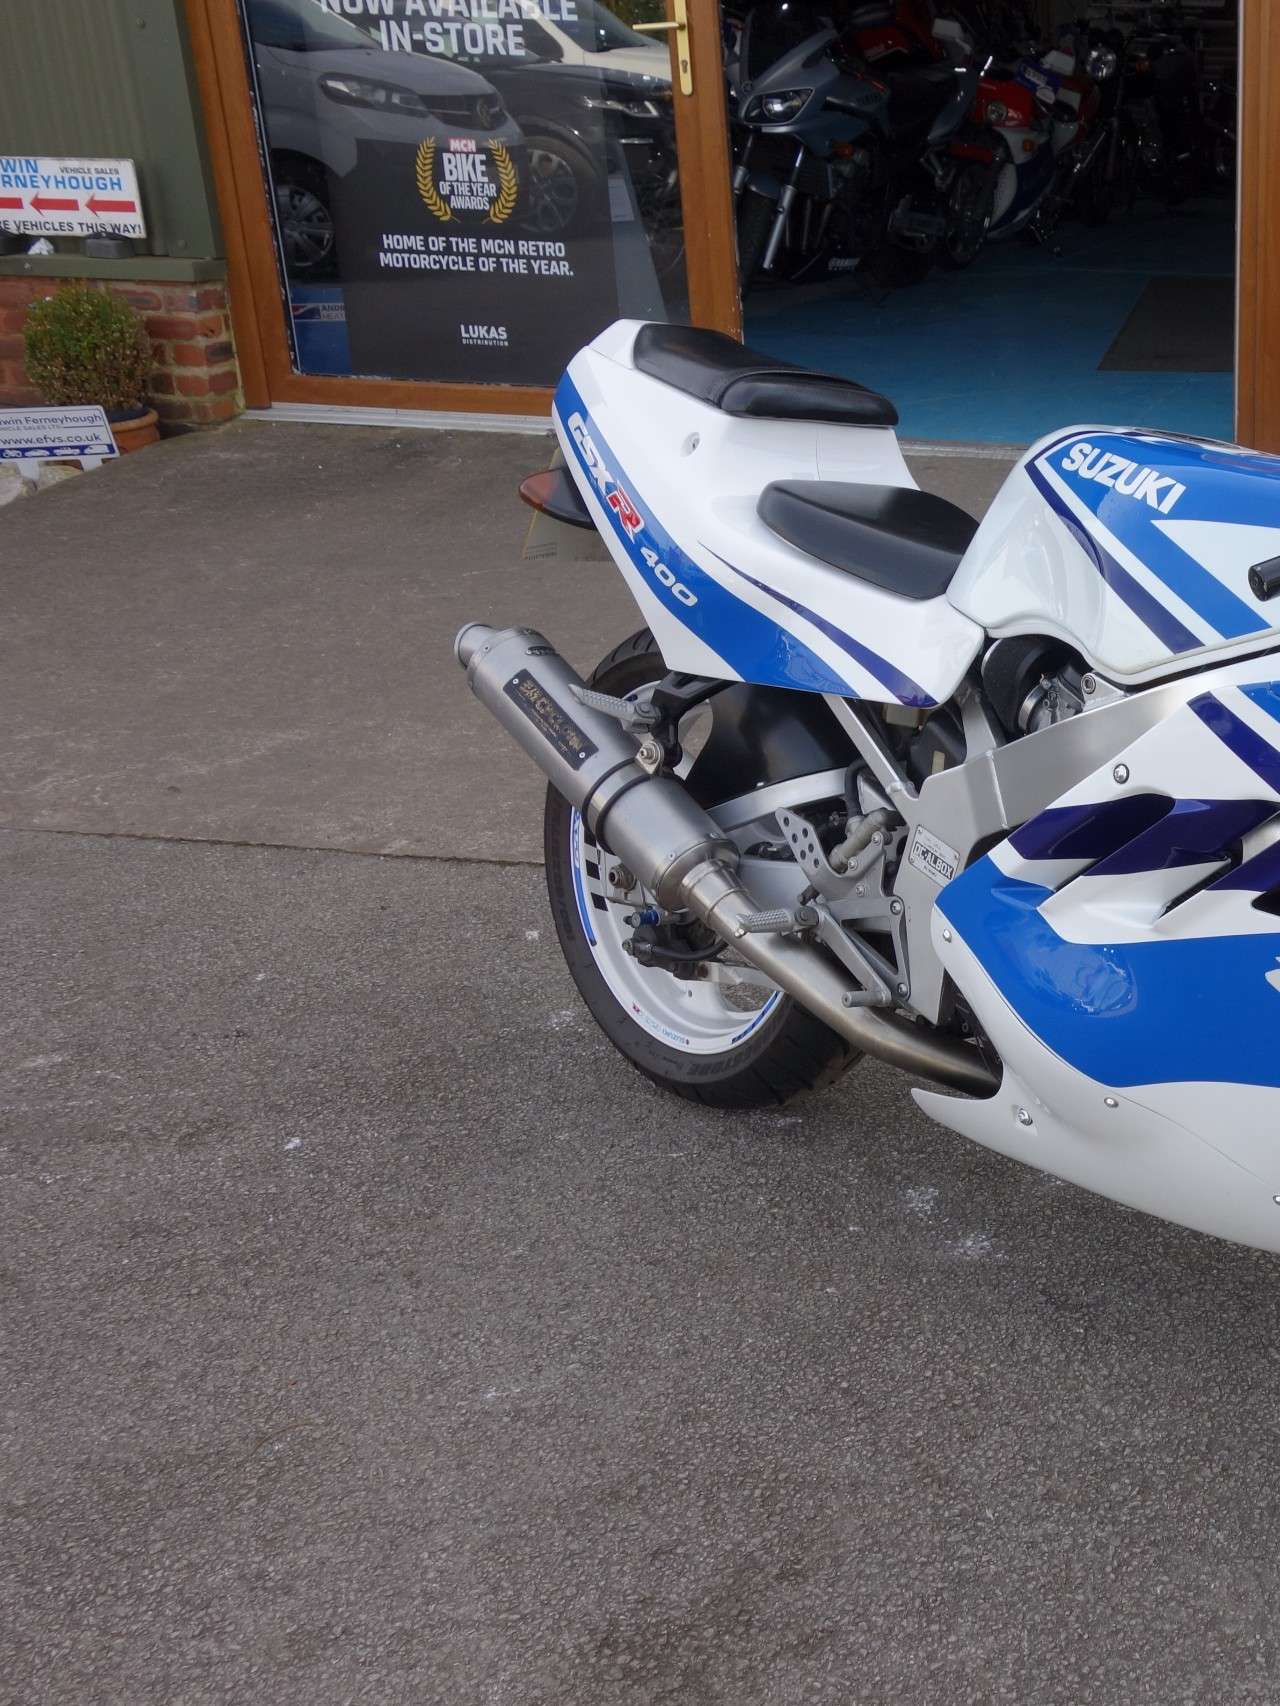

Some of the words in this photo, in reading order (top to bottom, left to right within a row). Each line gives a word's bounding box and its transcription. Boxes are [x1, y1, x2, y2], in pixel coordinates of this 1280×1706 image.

[380, 20, 526, 56] IN-STORE
[450, 139, 477, 153] MCN
[0, 159, 39, 174] WIN
[59, 167, 92, 175] VEHICLE
[442, 152, 489, 183] BIKE
[1, 174, 122, 191] RNEYHOUGH
[439, 181, 452, 195] OF
[453, 182, 470, 196] THE
[470, 183, 497, 197] YEAR
[450, 196, 490, 210] AWARDS
[14, 220, 74, 233] VEHICLES
[78, 222, 107, 234] THIS
[110, 223, 142, 235] WAY!
[383, 234, 426, 251] HOME
[428, 236, 447, 252] OF
[450, 237, 477, 253] THE
[481, 239, 515, 255] MCN
[518, 241, 566, 257] RETRO
[379, 252, 475, 272] MOTORCYCLE
[479, 257, 497, 272] OF
[500, 258, 528, 274] THE
[531, 260, 574, 276] YEAR.
[460, 324, 507, 340] LUKAS
[462, 338, 509, 347] DISTRIBUTION
[0, 415, 21, 426] win
[24, 413, 102, 425] Ferneyhough
[1, 433, 102, 445] www.efvs.co.uk
[1061, 443, 1187, 514] SUZUKI
[640, 546, 698, 607] 400
